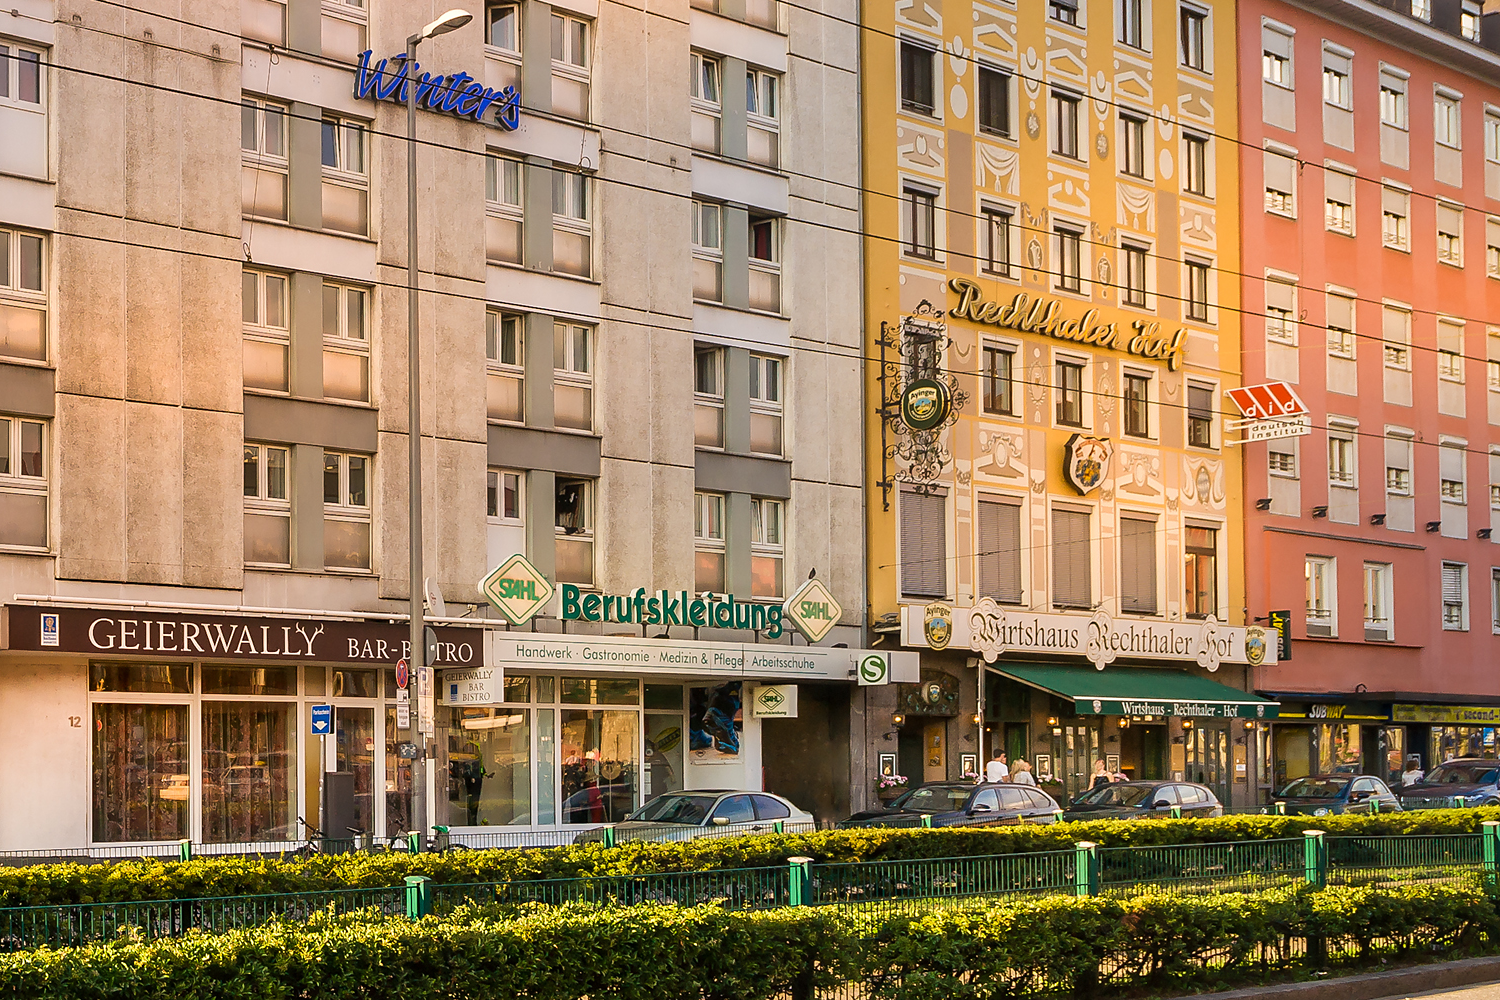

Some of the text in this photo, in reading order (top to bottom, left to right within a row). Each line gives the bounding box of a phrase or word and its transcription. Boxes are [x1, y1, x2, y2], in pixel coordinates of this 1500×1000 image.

[358, 48, 521, 131] Winter's
[949, 277, 1189, 371] Rechthaler Hof
[1245, 398, 1295, 417] did
[1251, 419, 1304, 432] deutsch
[1251, 426, 1304, 439] institut
[499, 577, 540, 601] STAHL
[560, 583, 783, 639] Berufskleidung
[800, 600, 833, 620] STAHL
[926, 604, 951, 617] Ayinger
[88, 617, 473, 663] GEIERWALLY BAR-BTRO
[971, 611, 1235, 663] Wirtshaus Rechthaler Hof
[516, 645, 815, 669] Handwerk Gastronomie Medizin & Pflege Arbeitsschuhe
[445, 670, 493, 682] GEIERWALLY
[468, 682, 485, 692] BAR
[462, 692, 491, 702] BISTRO
[1121, 701, 1165, 716] Wirtshaus
[1173, 703, 1215, 717] Rechthaler
[1223, 704, 1239, 718] Hof
[1309, 704, 1347, 719] SUBWAY
[1463, 709, 1500, 721] second-
[68, 715, 82, 728] 12
